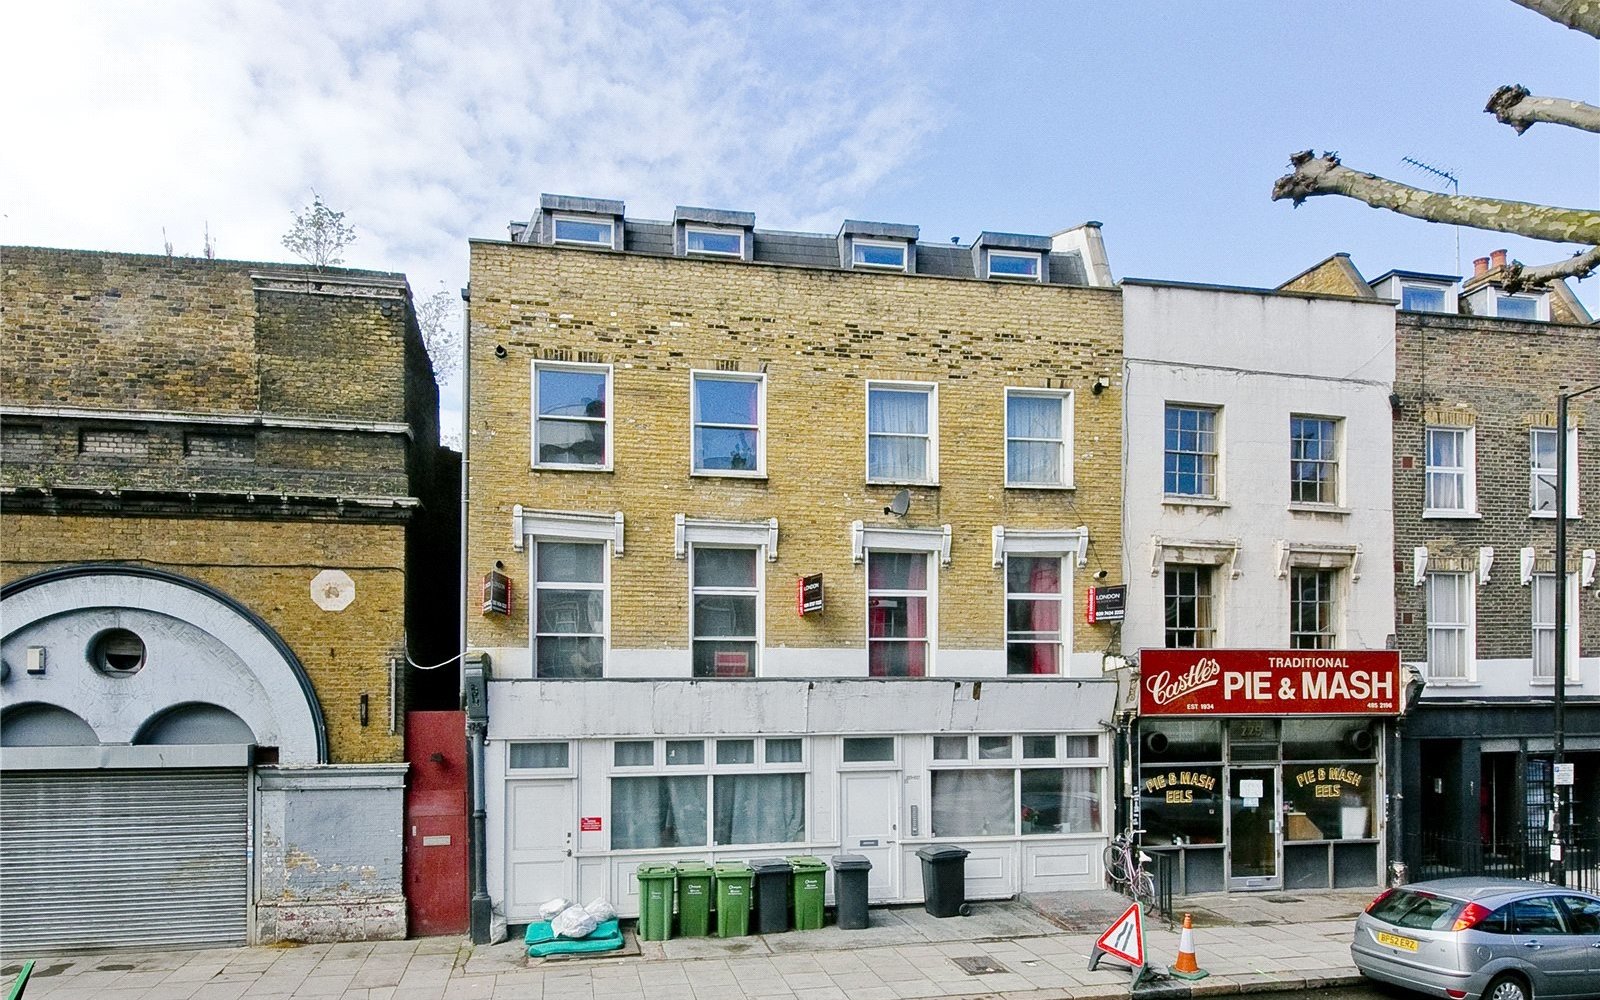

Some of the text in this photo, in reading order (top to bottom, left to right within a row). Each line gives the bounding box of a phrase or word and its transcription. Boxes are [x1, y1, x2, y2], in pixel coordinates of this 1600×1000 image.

[1268, 657, 1350, 668] TRADITIONAL
[1146, 658, 1221, 704] Castle's
[1223, 670, 1393, 700] PIE & MASH
[1145, 774, 1167, 793] PIE
[1180, 771, 1216, 791] MASH
[1295, 769, 1316, 788] PIE
[1328, 767, 1363, 787] MASH
[1166, 789, 1194, 804] EELS
[1315, 784, 1341, 798] EELS
